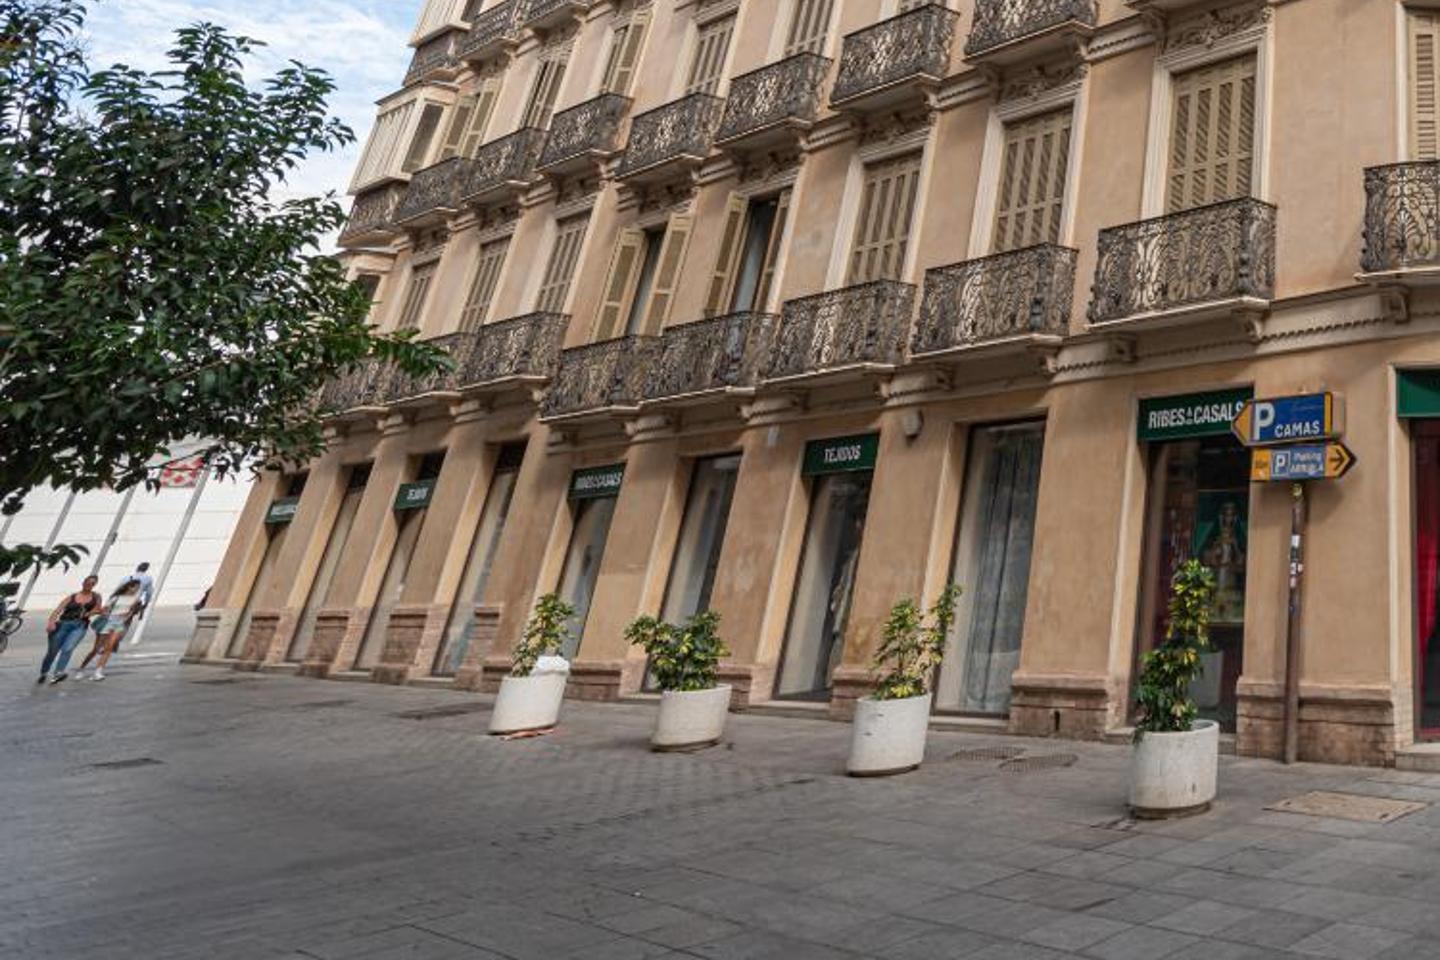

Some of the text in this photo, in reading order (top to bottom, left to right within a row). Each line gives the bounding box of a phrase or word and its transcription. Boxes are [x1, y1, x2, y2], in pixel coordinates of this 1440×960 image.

[1148, 407, 1186, 429] RIBES
[1255, 403, 1275, 440] P
[1275, 420, 1320, 438] CAMAS
[824, 444, 861, 462] TEJIDOS
[1275, 454, 1286, 474] P
